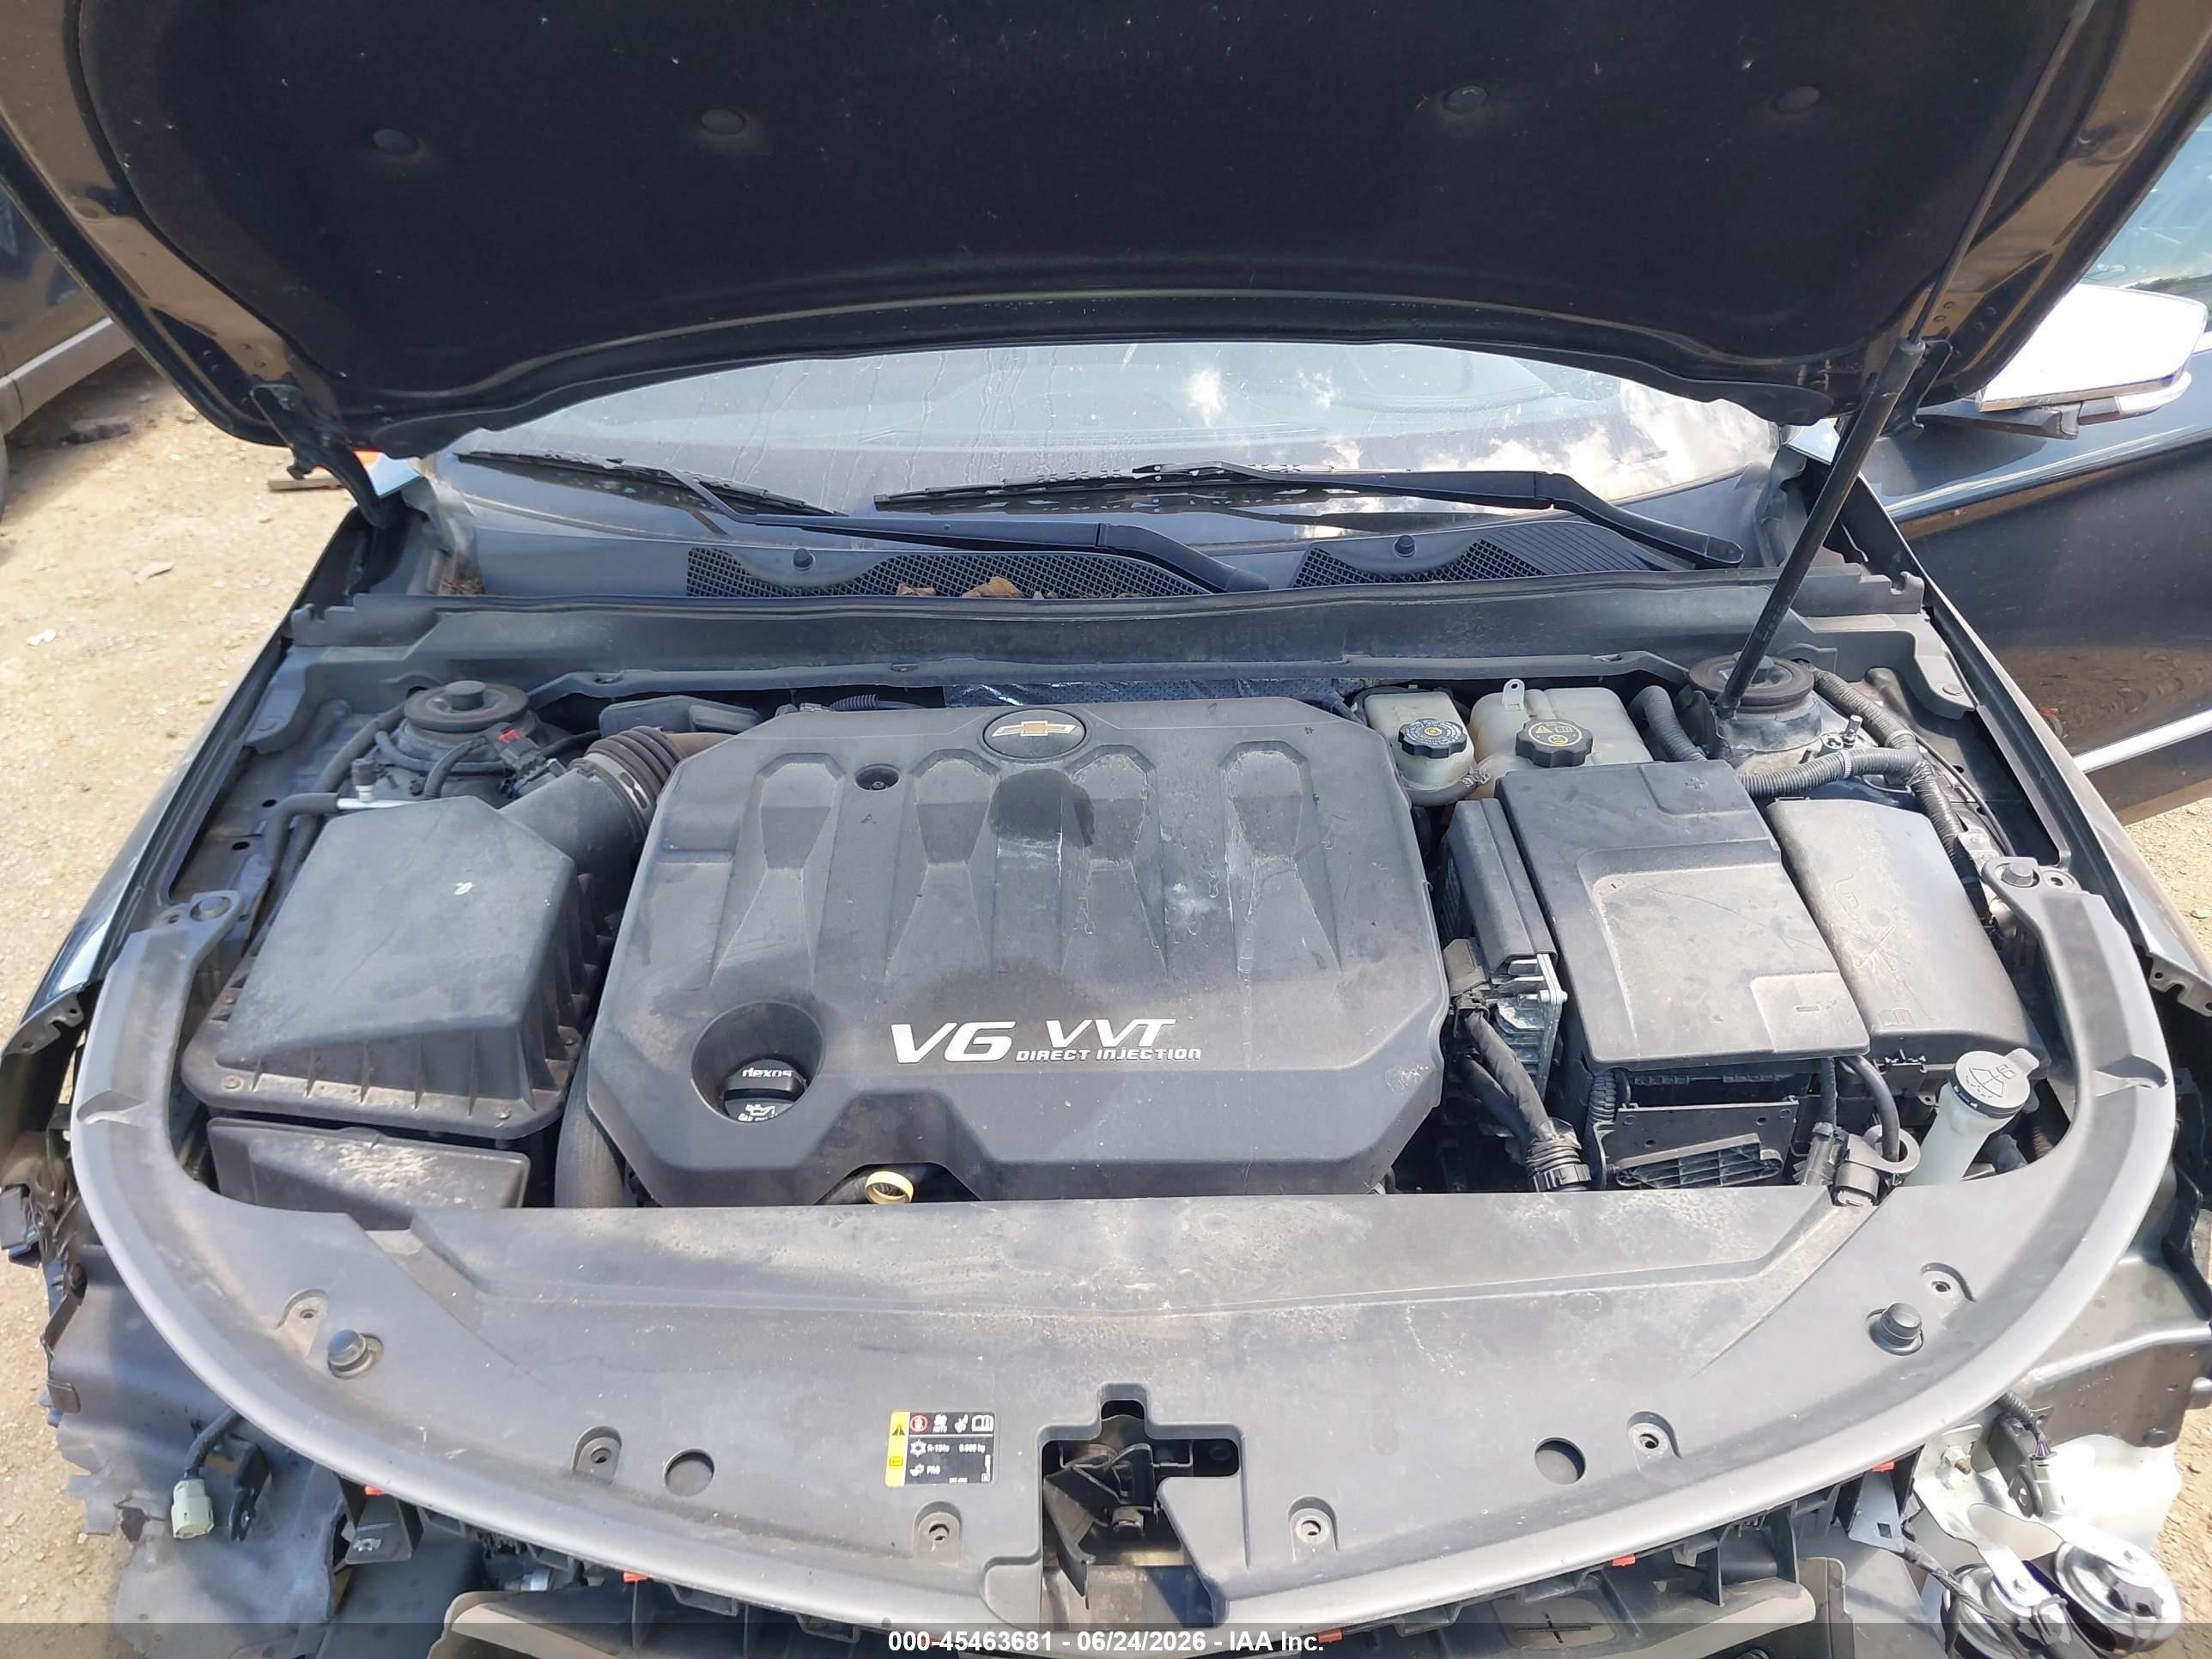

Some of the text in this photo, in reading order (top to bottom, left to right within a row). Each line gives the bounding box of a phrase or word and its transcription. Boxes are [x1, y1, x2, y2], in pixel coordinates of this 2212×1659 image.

[890, 1018, 1176, 1064] V6 VVT
[1015, 1048, 1202, 1062] DIRECT INJECTION
[741, 1066, 795, 1079] dexos
